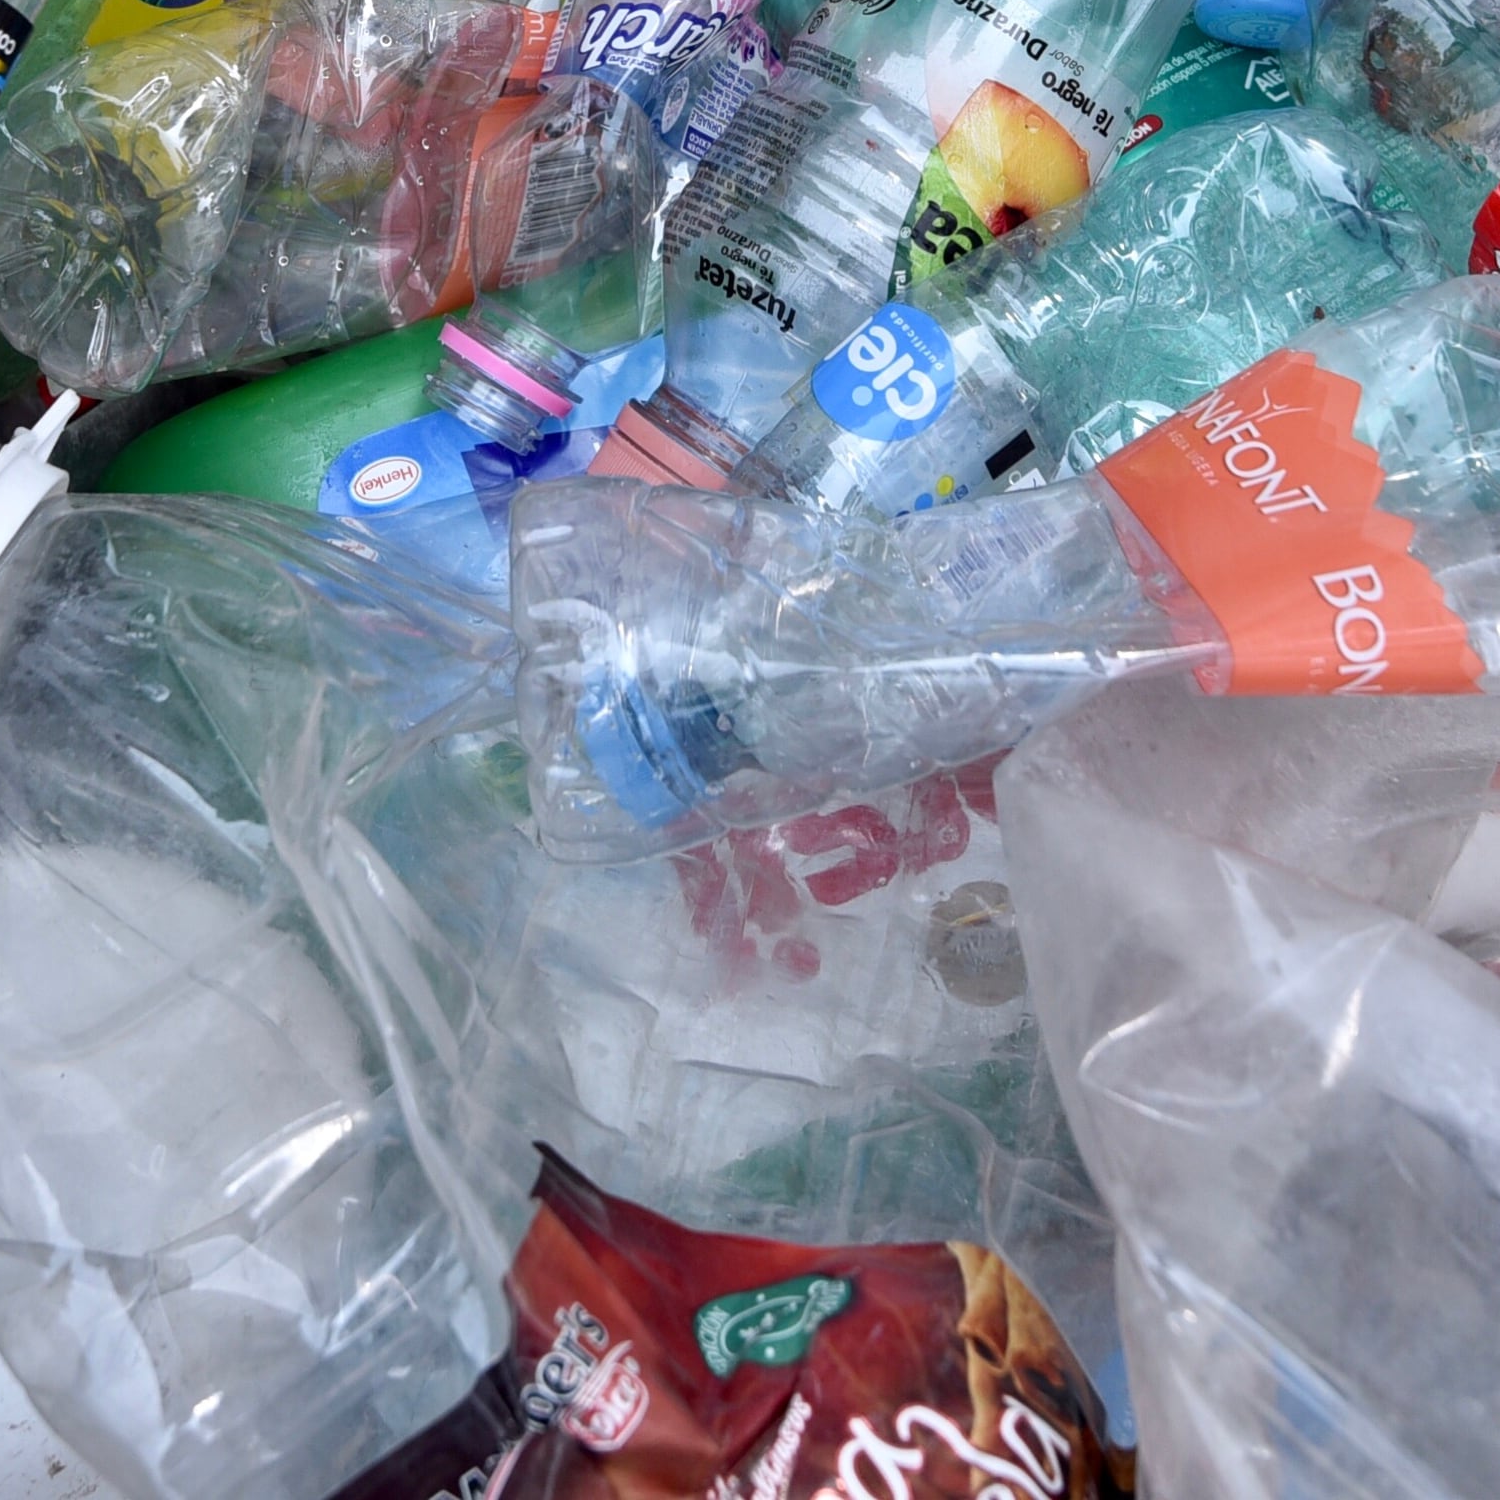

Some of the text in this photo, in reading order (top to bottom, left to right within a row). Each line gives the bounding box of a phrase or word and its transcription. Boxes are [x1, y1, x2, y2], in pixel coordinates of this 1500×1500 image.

[1047, 42, 1086, 80] Sabor
[1168, 59, 1202, 86] espere
[1037, 61, 1120, 138] Té negro
[713, 224, 773, 263] Durazno
[904, 197, 991, 275] ea
[717, 241, 779, 285] Té negro
[686, 254, 804, 335] fuzetea
[888, 305, 945, 374] purificada
[357, 465, 414, 495] Henkel
[1185, 448, 1219, 490] LIGERA
[1312, 564, 1387, 695] BON
